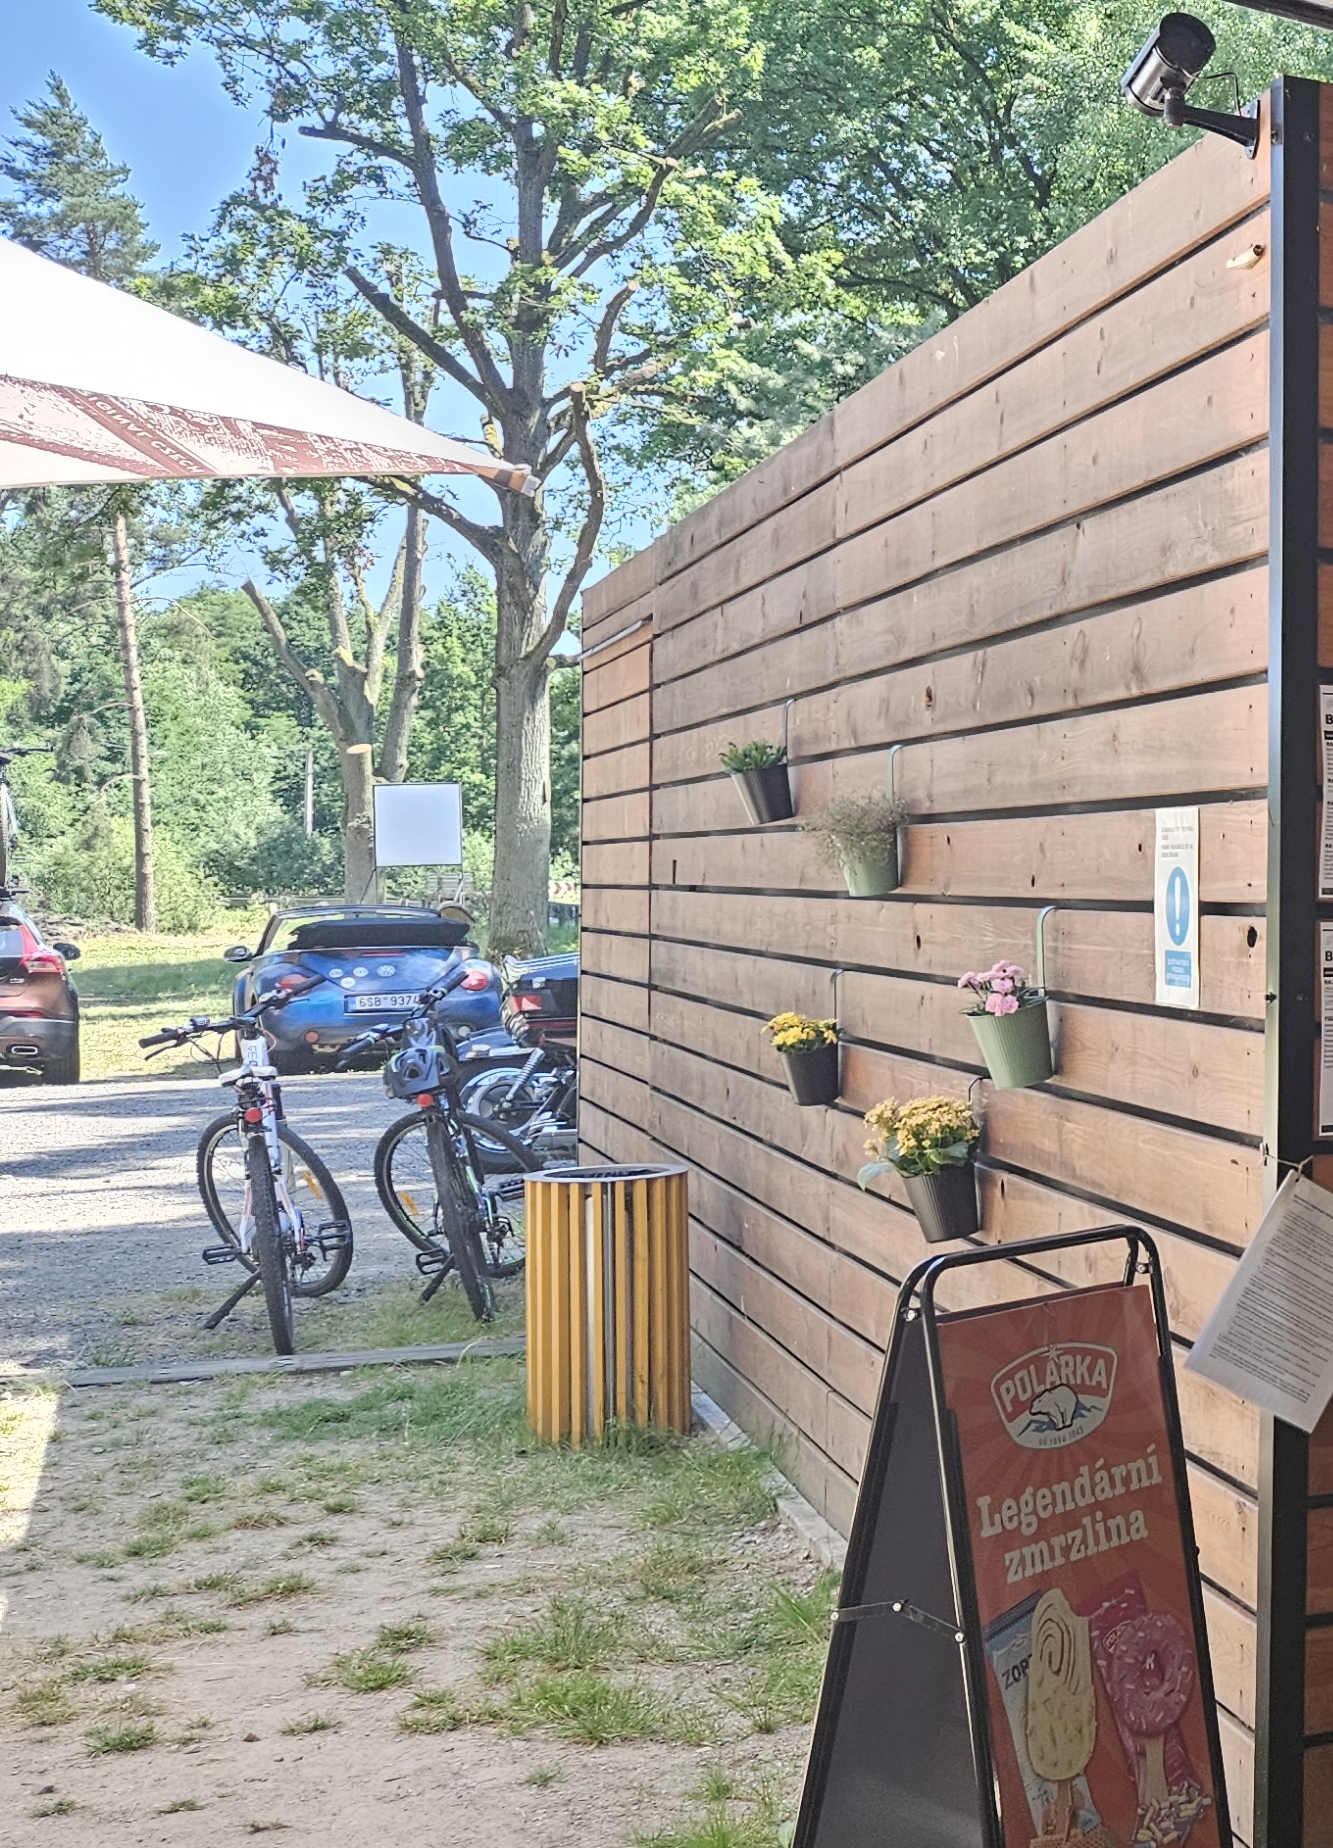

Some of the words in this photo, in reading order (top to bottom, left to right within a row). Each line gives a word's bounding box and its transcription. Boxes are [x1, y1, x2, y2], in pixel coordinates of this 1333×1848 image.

[359, 995, 382, 1007] 6SB
[999, 1353, 1108, 1413] POLÁRKA
[976, 1443, 1163, 1538] Legendární
[1004, 1509, 1149, 1585] zmrzlina
[1001, 1653, 1032, 1691] ZOR
